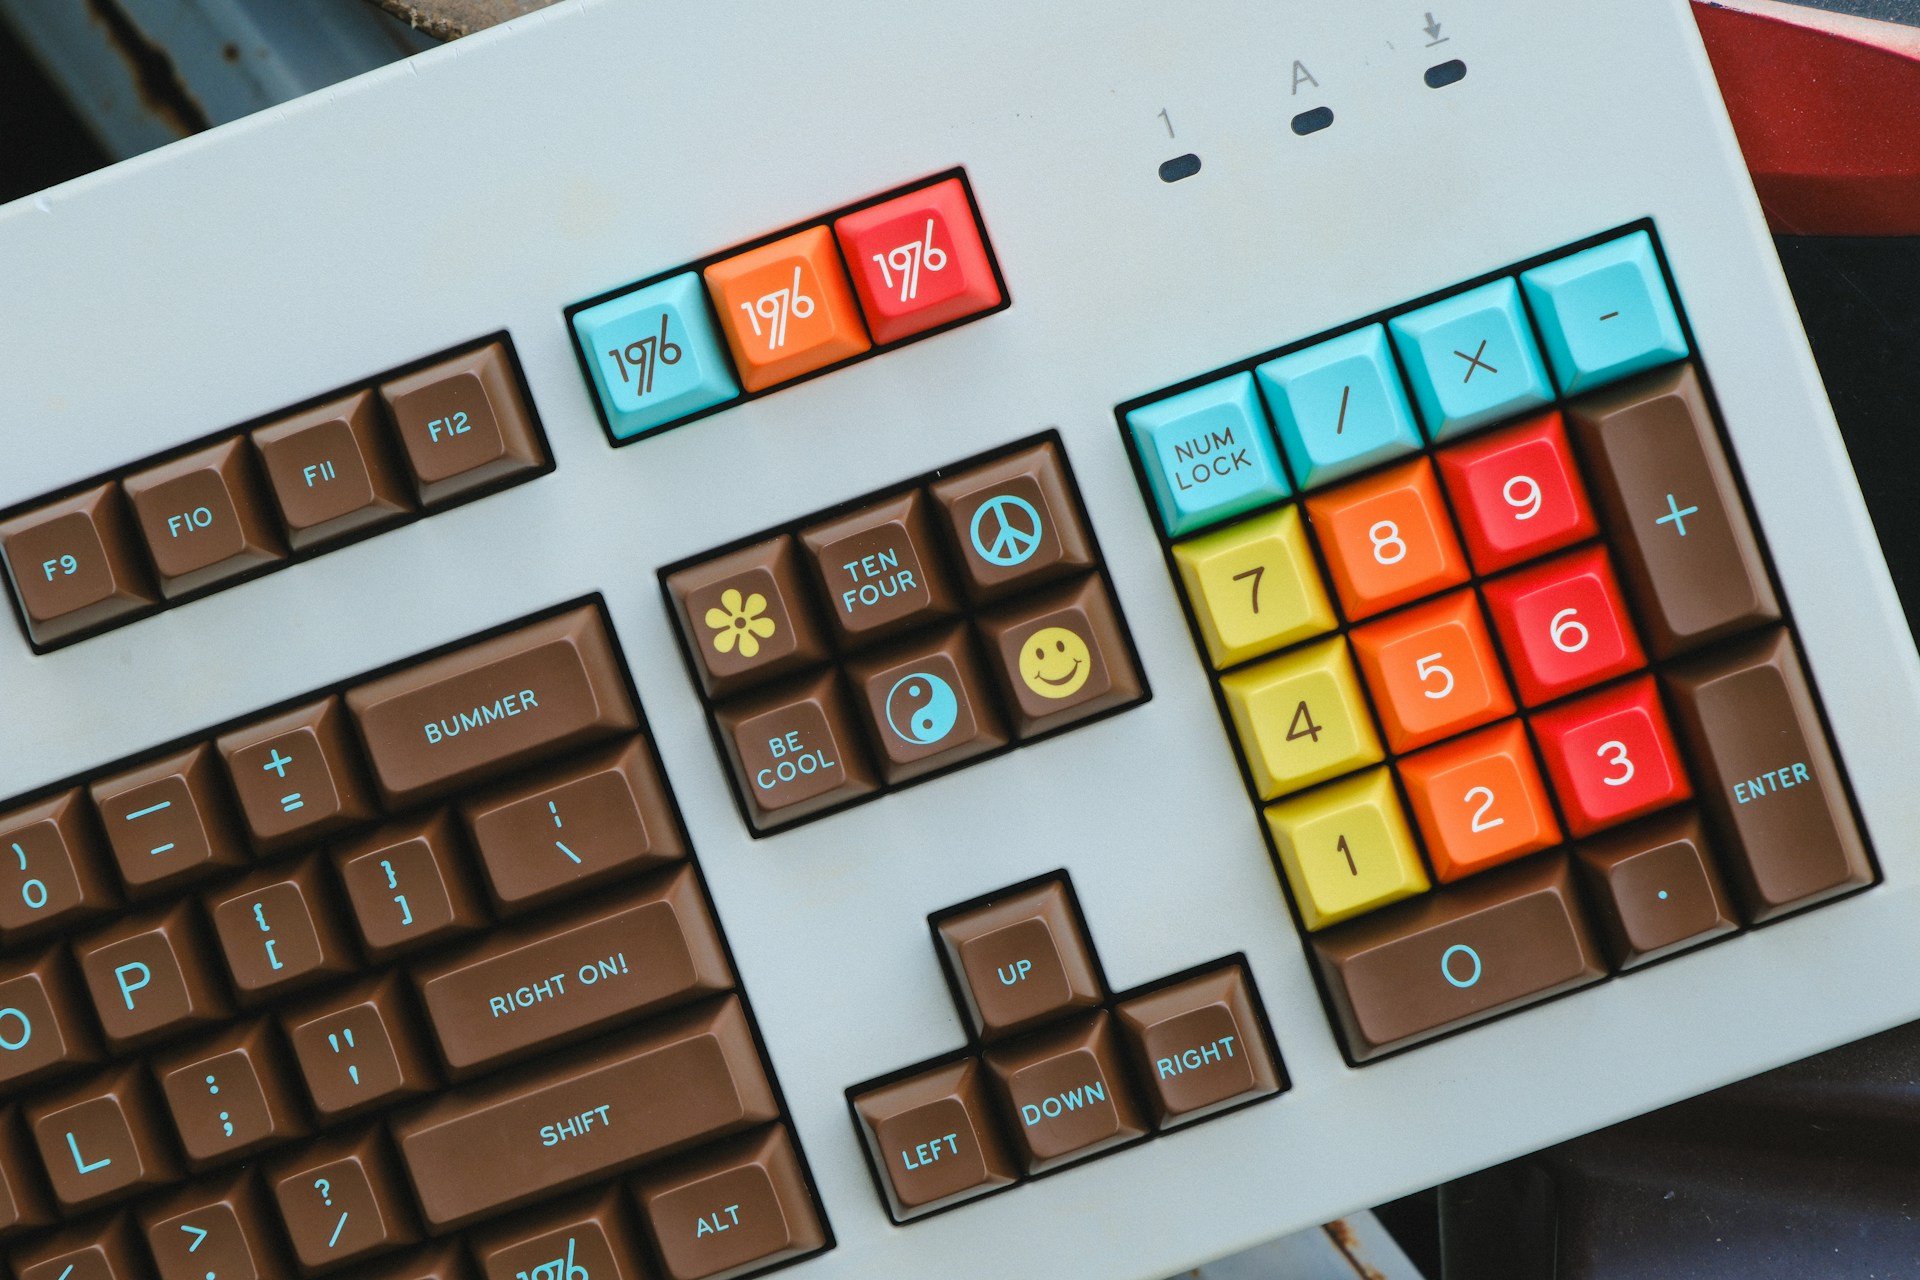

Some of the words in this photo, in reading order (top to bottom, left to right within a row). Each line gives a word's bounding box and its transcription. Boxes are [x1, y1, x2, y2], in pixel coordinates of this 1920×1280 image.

[1291, 59, 1320, 96] A
[1157, 107, 1176, 139] 1
[872, 218, 947, 303] 1976
[740, 266, 815, 351] 1976
[608, 313, 682, 397] 1976
[427, 411, 472, 443] F12
[1174, 426, 1235, 463] NUM
[303, 458, 338, 488] F11
[1175, 448, 1252, 491] LOCK
[1502, 475, 1542, 521] 9
[1655, 494, 1698, 537] +
[167, 507, 213, 538] F10
[1368, 520, 1407, 565] 8
[42, 554, 78, 582] F9
[843, 548, 899, 583] TEN
[842, 570, 917, 613] FOUR
[1232, 565, 1266, 614] 7
[1549, 607, 1589, 653] 6
[1416, 652, 1455, 699] 5
[424, 689, 538, 744] BUMMER
[1285, 700, 1323, 743] 4
[263, 748, 293, 778] +
[768, 731, 804, 759] BE
[1596, 740, 1635, 786] 3
[756, 750, 834, 790] COOL
[1733, 762, 1810, 805] ENTER
[280, 792, 305, 813] =
[1463, 786, 1505, 833] 2
[11, 842, 27, 871] )
[380, 860, 398, 890] }
[1336, 834, 1358, 877] 1
[253, 903, 271, 932] {
[394, 895, 413, 926] ]
[264, 939, 283, 970] [
[997, 959, 1032, 986] UP
[114, 961, 151, 1011] P
[489, 972, 566, 1017] RIGHT
[578, 953, 629, 985] ON!
[1156, 1036, 1235, 1080] RIGHT
[539, 1104, 611, 1147] SHIFT
[1021, 1081, 1105, 1127] DOWN
[66, 1132, 111, 1175] L
[901, 1133, 959, 1171] LEFT
[314, 1178, 332, 1206] ?
[696, 1205, 741, 1238] ALT
